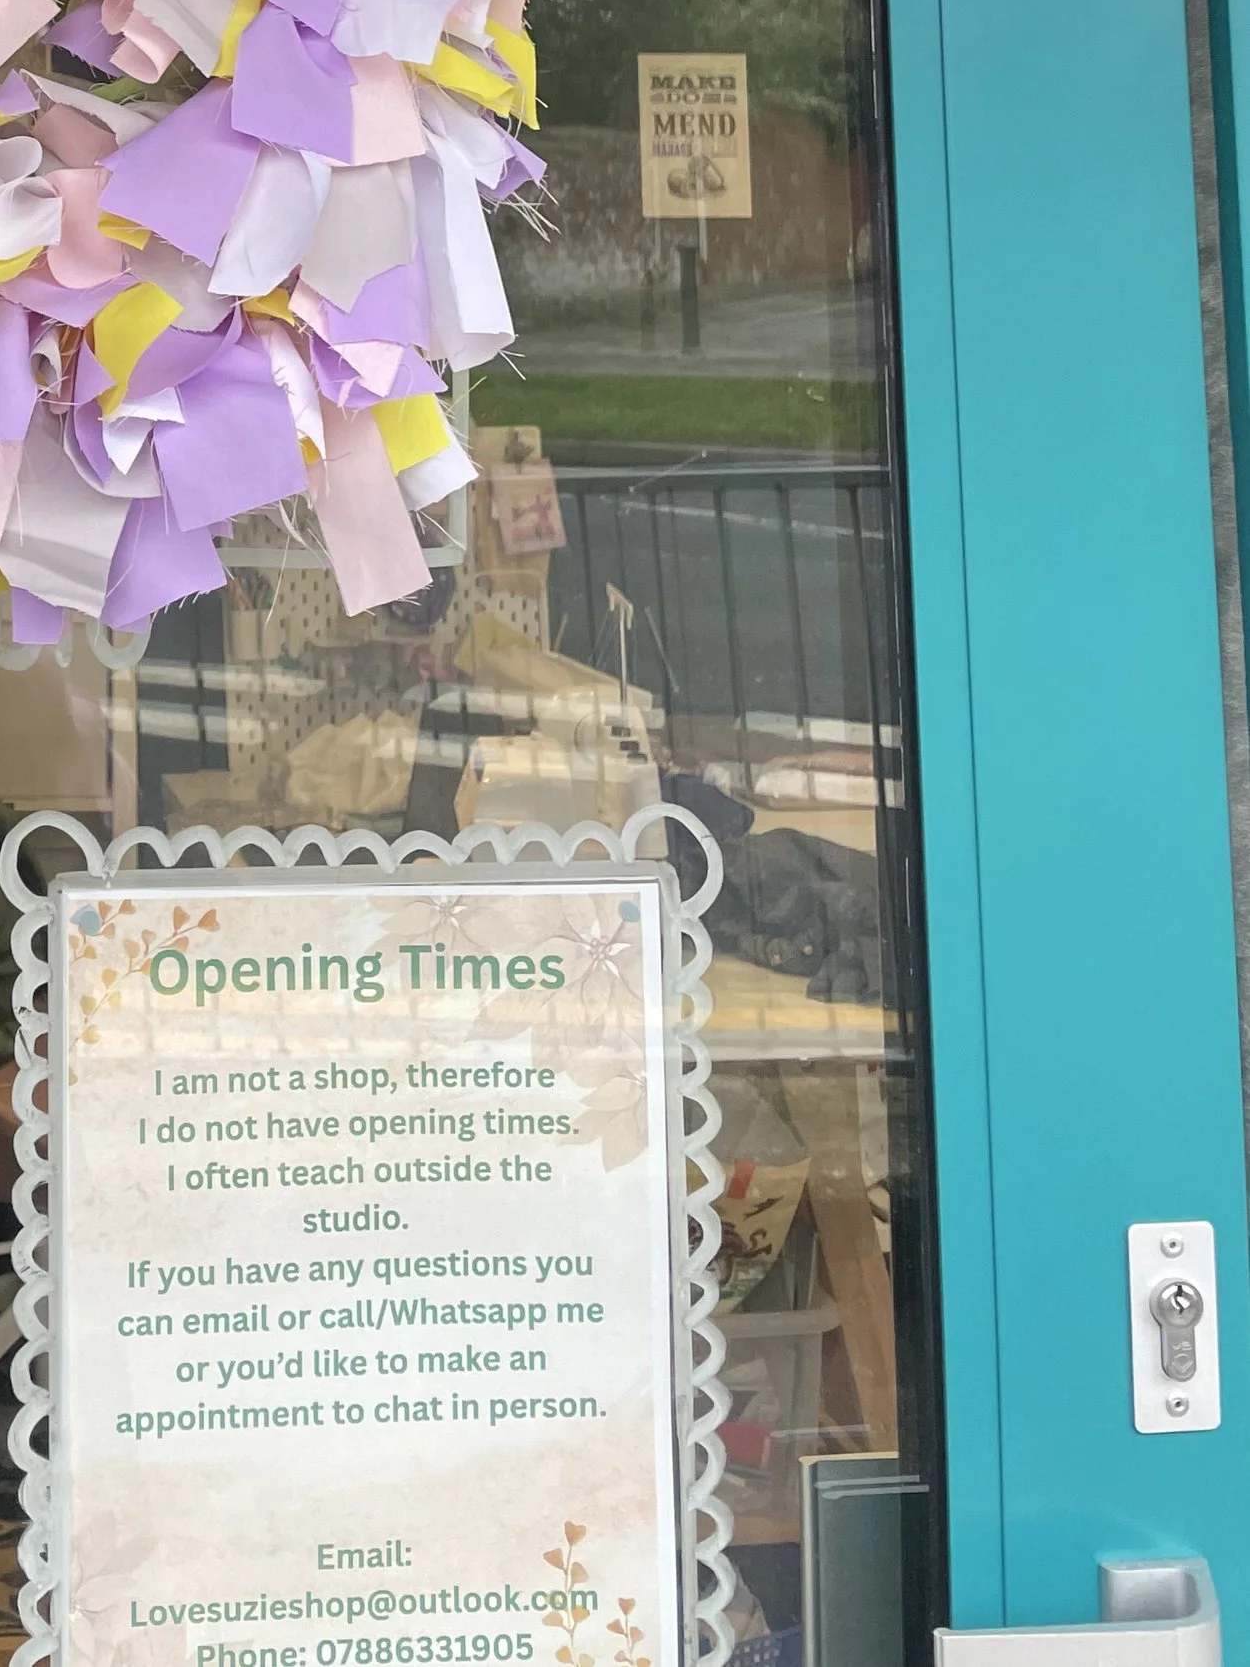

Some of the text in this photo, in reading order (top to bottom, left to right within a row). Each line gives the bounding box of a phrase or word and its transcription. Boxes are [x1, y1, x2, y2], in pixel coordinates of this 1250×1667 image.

[650, 75, 736, 90] MAKE
[653, 112, 736, 138] MEND
[148, 942, 565, 1007] Opening Times
[154, 1060, 556, 1096] I am not a shop, therefore
[138, 1108, 579, 1144] I do not have opening times.
[167, 1154, 553, 1192] I often teach outside the
[302, 1203, 409, 1234] studio.
[128, 1250, 593, 1295] If you have any questions you
[117, 1297, 605, 1338] can email or call/Whatsapp me
[175, 1344, 547, 1389] or you’d like to make an
[115, 1392, 607, 1441] appointment to chat in person.
[317, 1539, 412, 1571] Email:
[130, 1583, 599, 1628] Lovesuzieshop@outlook.com
[197, 1633, 534, 1667] Phone: 07886331905
